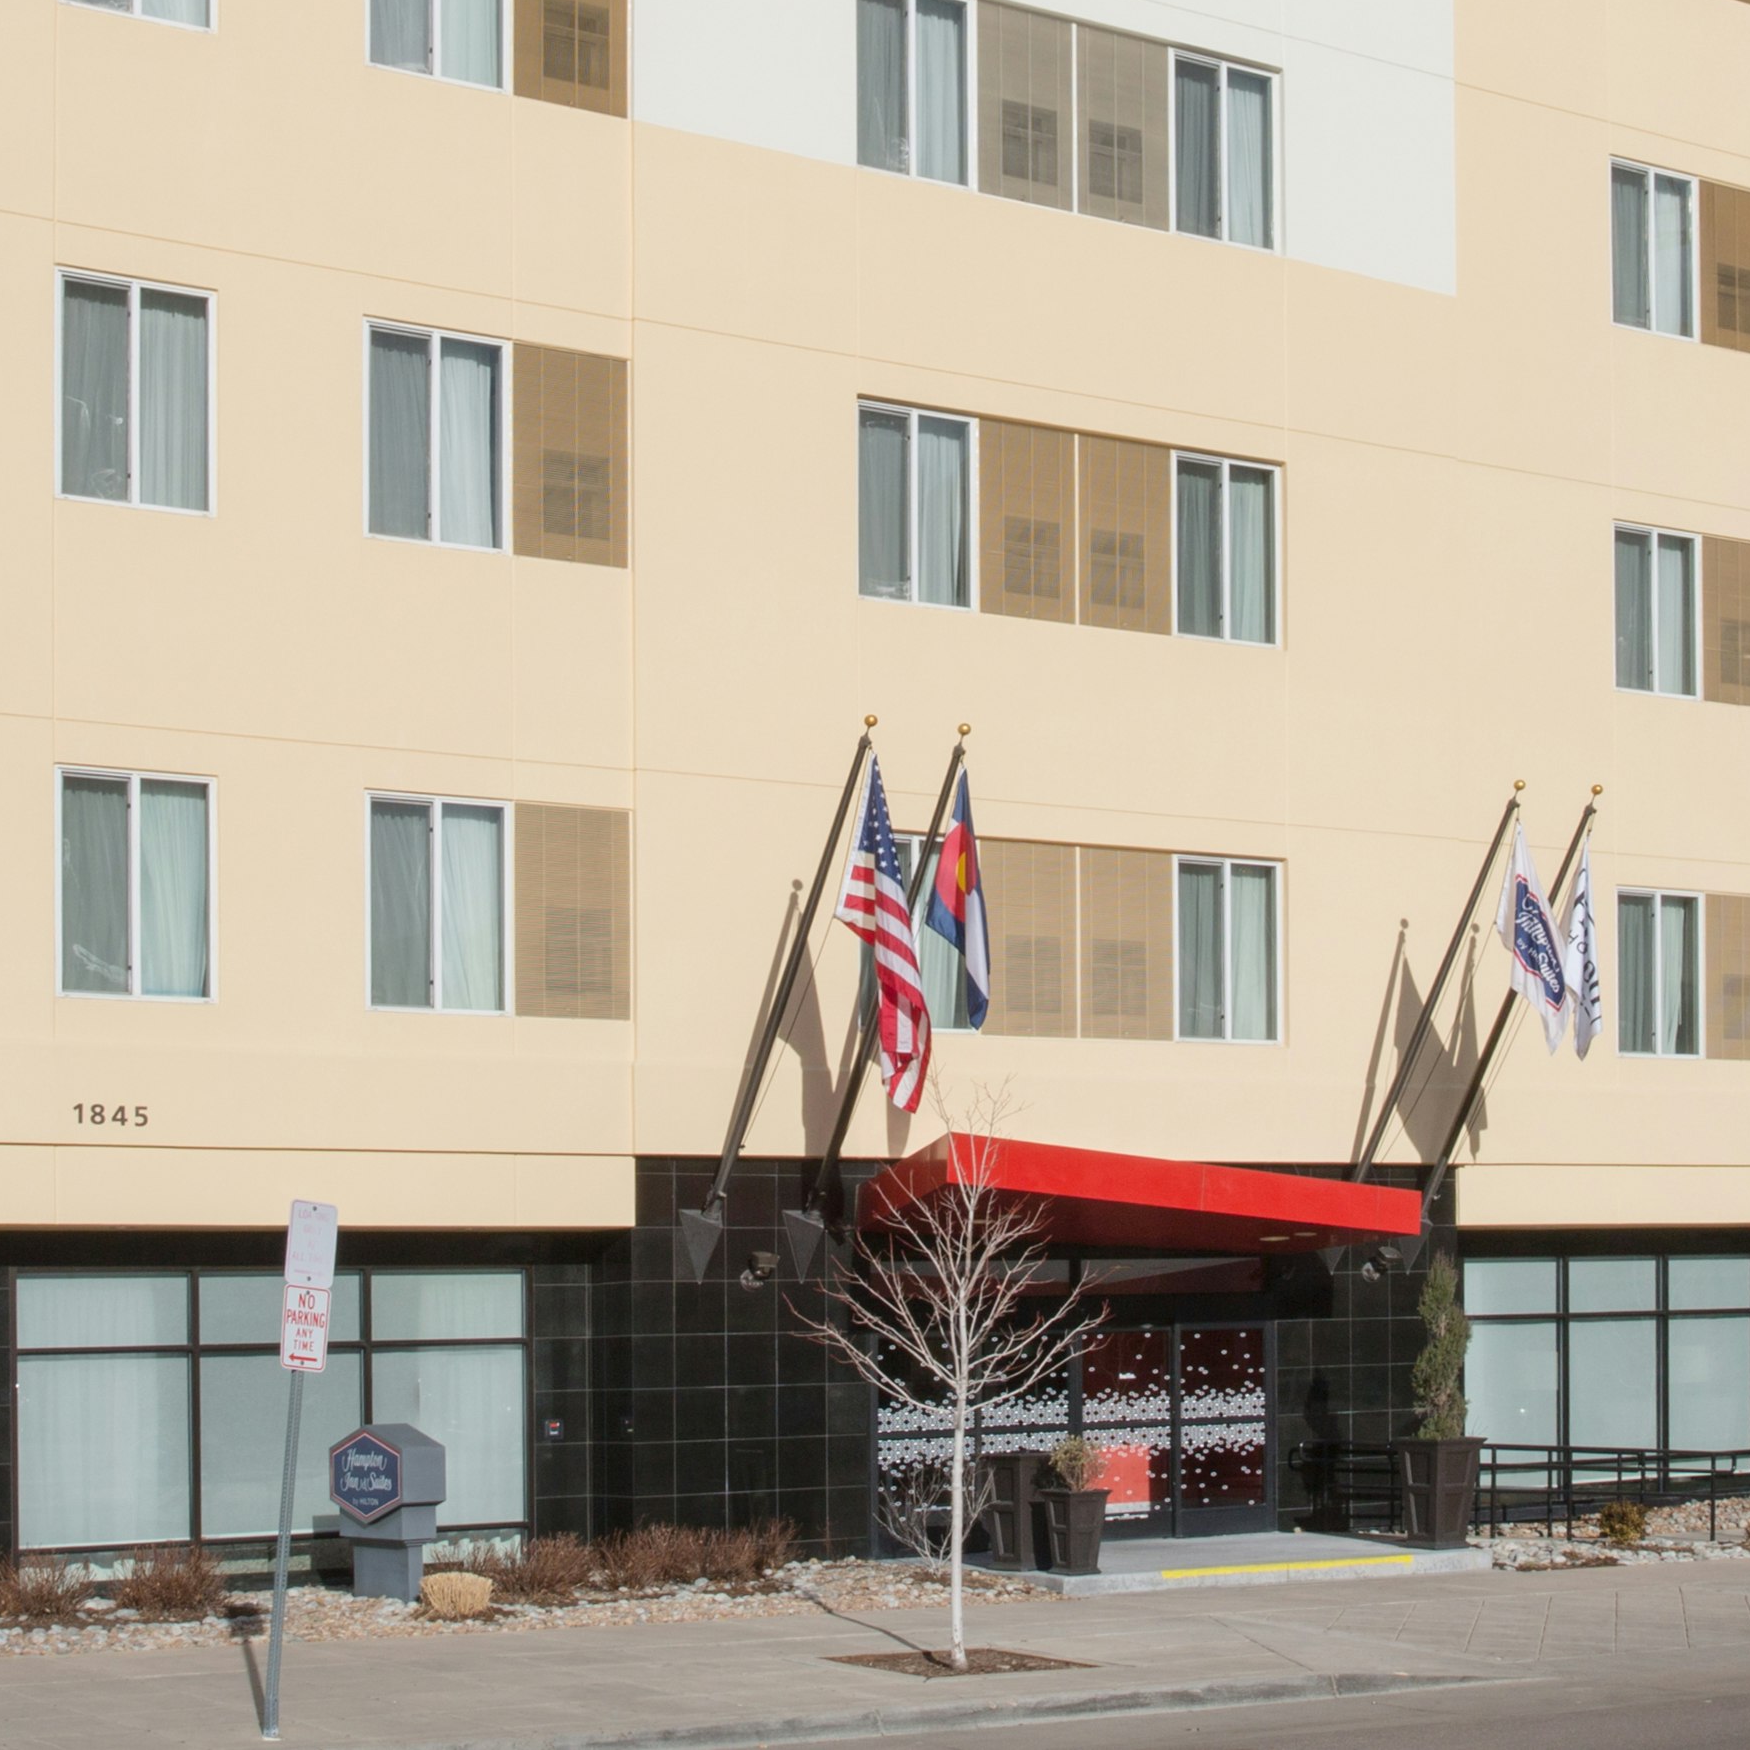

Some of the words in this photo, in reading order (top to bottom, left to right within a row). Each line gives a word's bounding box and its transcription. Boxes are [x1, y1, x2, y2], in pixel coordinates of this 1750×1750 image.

[73, 1103, 148, 1127] 1845
[298, 1293, 316, 1310] NO
[286, 1309, 325, 1328] PARKING
[296, 1328, 314, 1339] ANY
[293, 1339, 315, 1352] TIME
[342, 1448, 388, 1472] Hampton
[340, 1472, 363, 1492] Inn
[368, 1472, 392, 1492] Suites
[359, 1498, 379, 1507] HILTON
